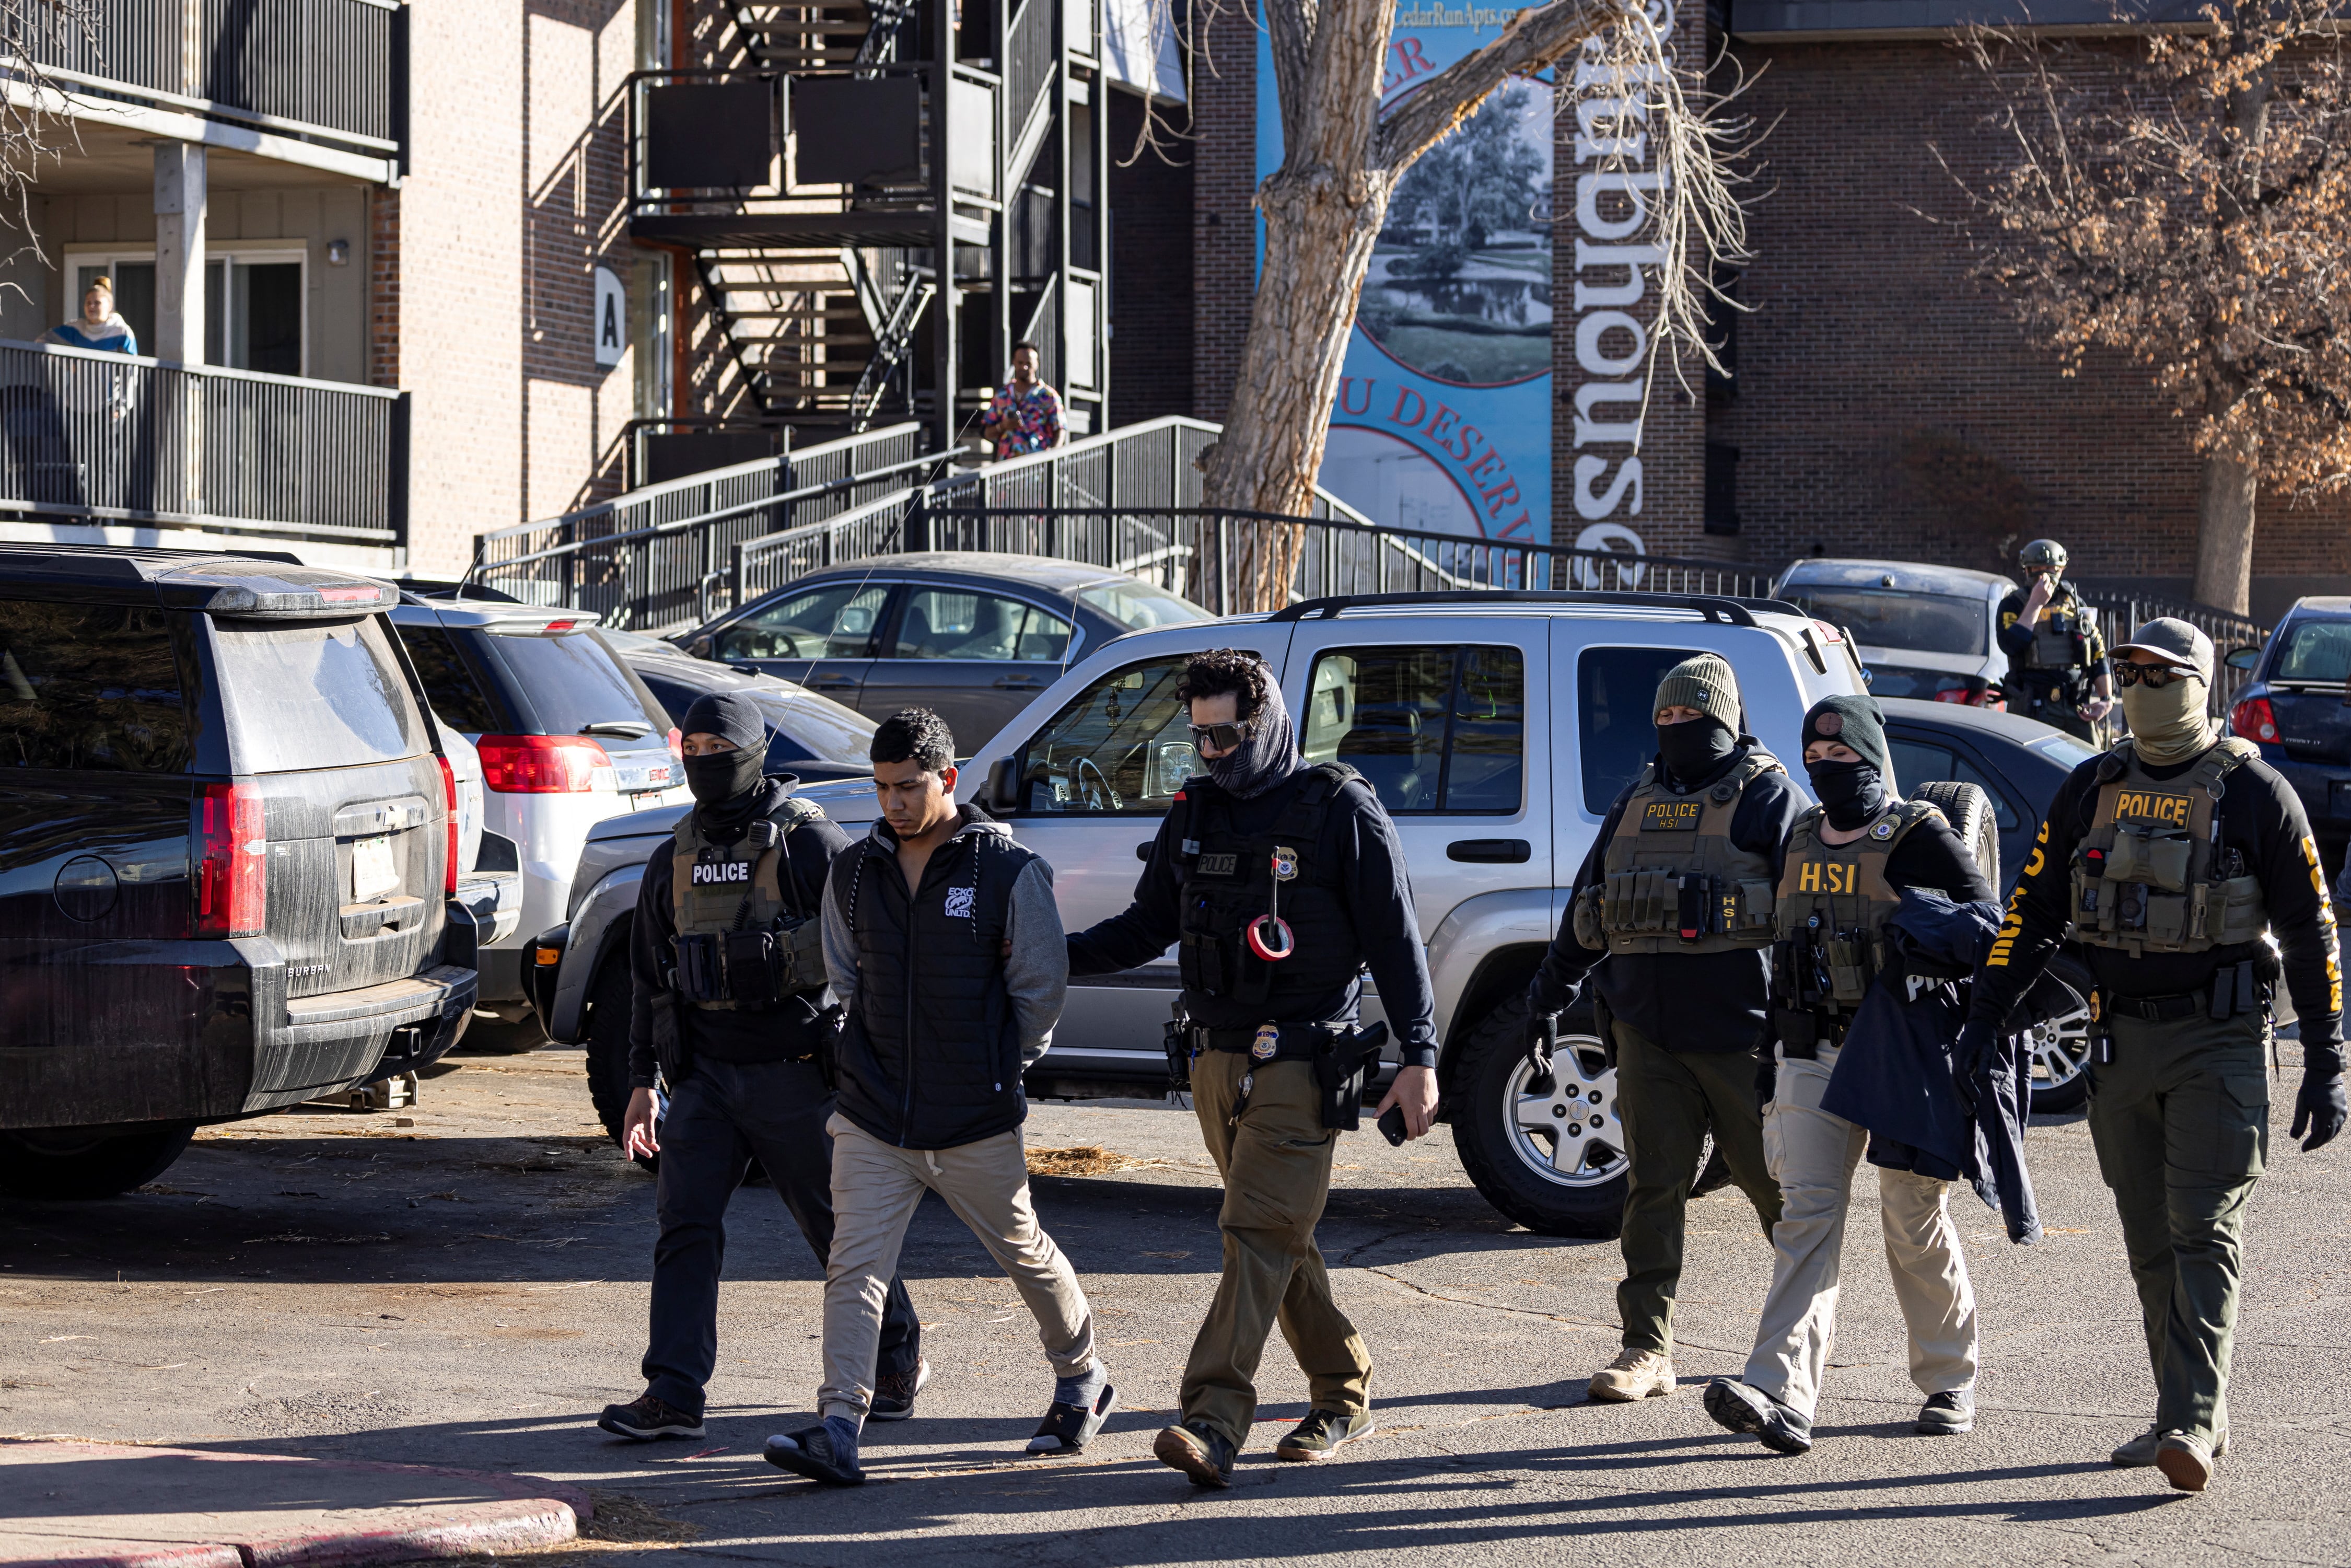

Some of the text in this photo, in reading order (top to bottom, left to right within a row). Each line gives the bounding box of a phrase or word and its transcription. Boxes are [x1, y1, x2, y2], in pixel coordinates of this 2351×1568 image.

[603, 293, 618, 347] A
[1646, 804, 1699, 817] POLICE
[2116, 794, 2188, 826] POLICE
[1659, 819, 1679, 828] HSI
[693, 863, 748, 883] POLICE
[1199, 855, 1236, 873] POLICE
[1799, 863, 1855, 893] HSI
[1723, 897, 1735, 928] HSI
[286, 963, 331, 978] BURBAN
